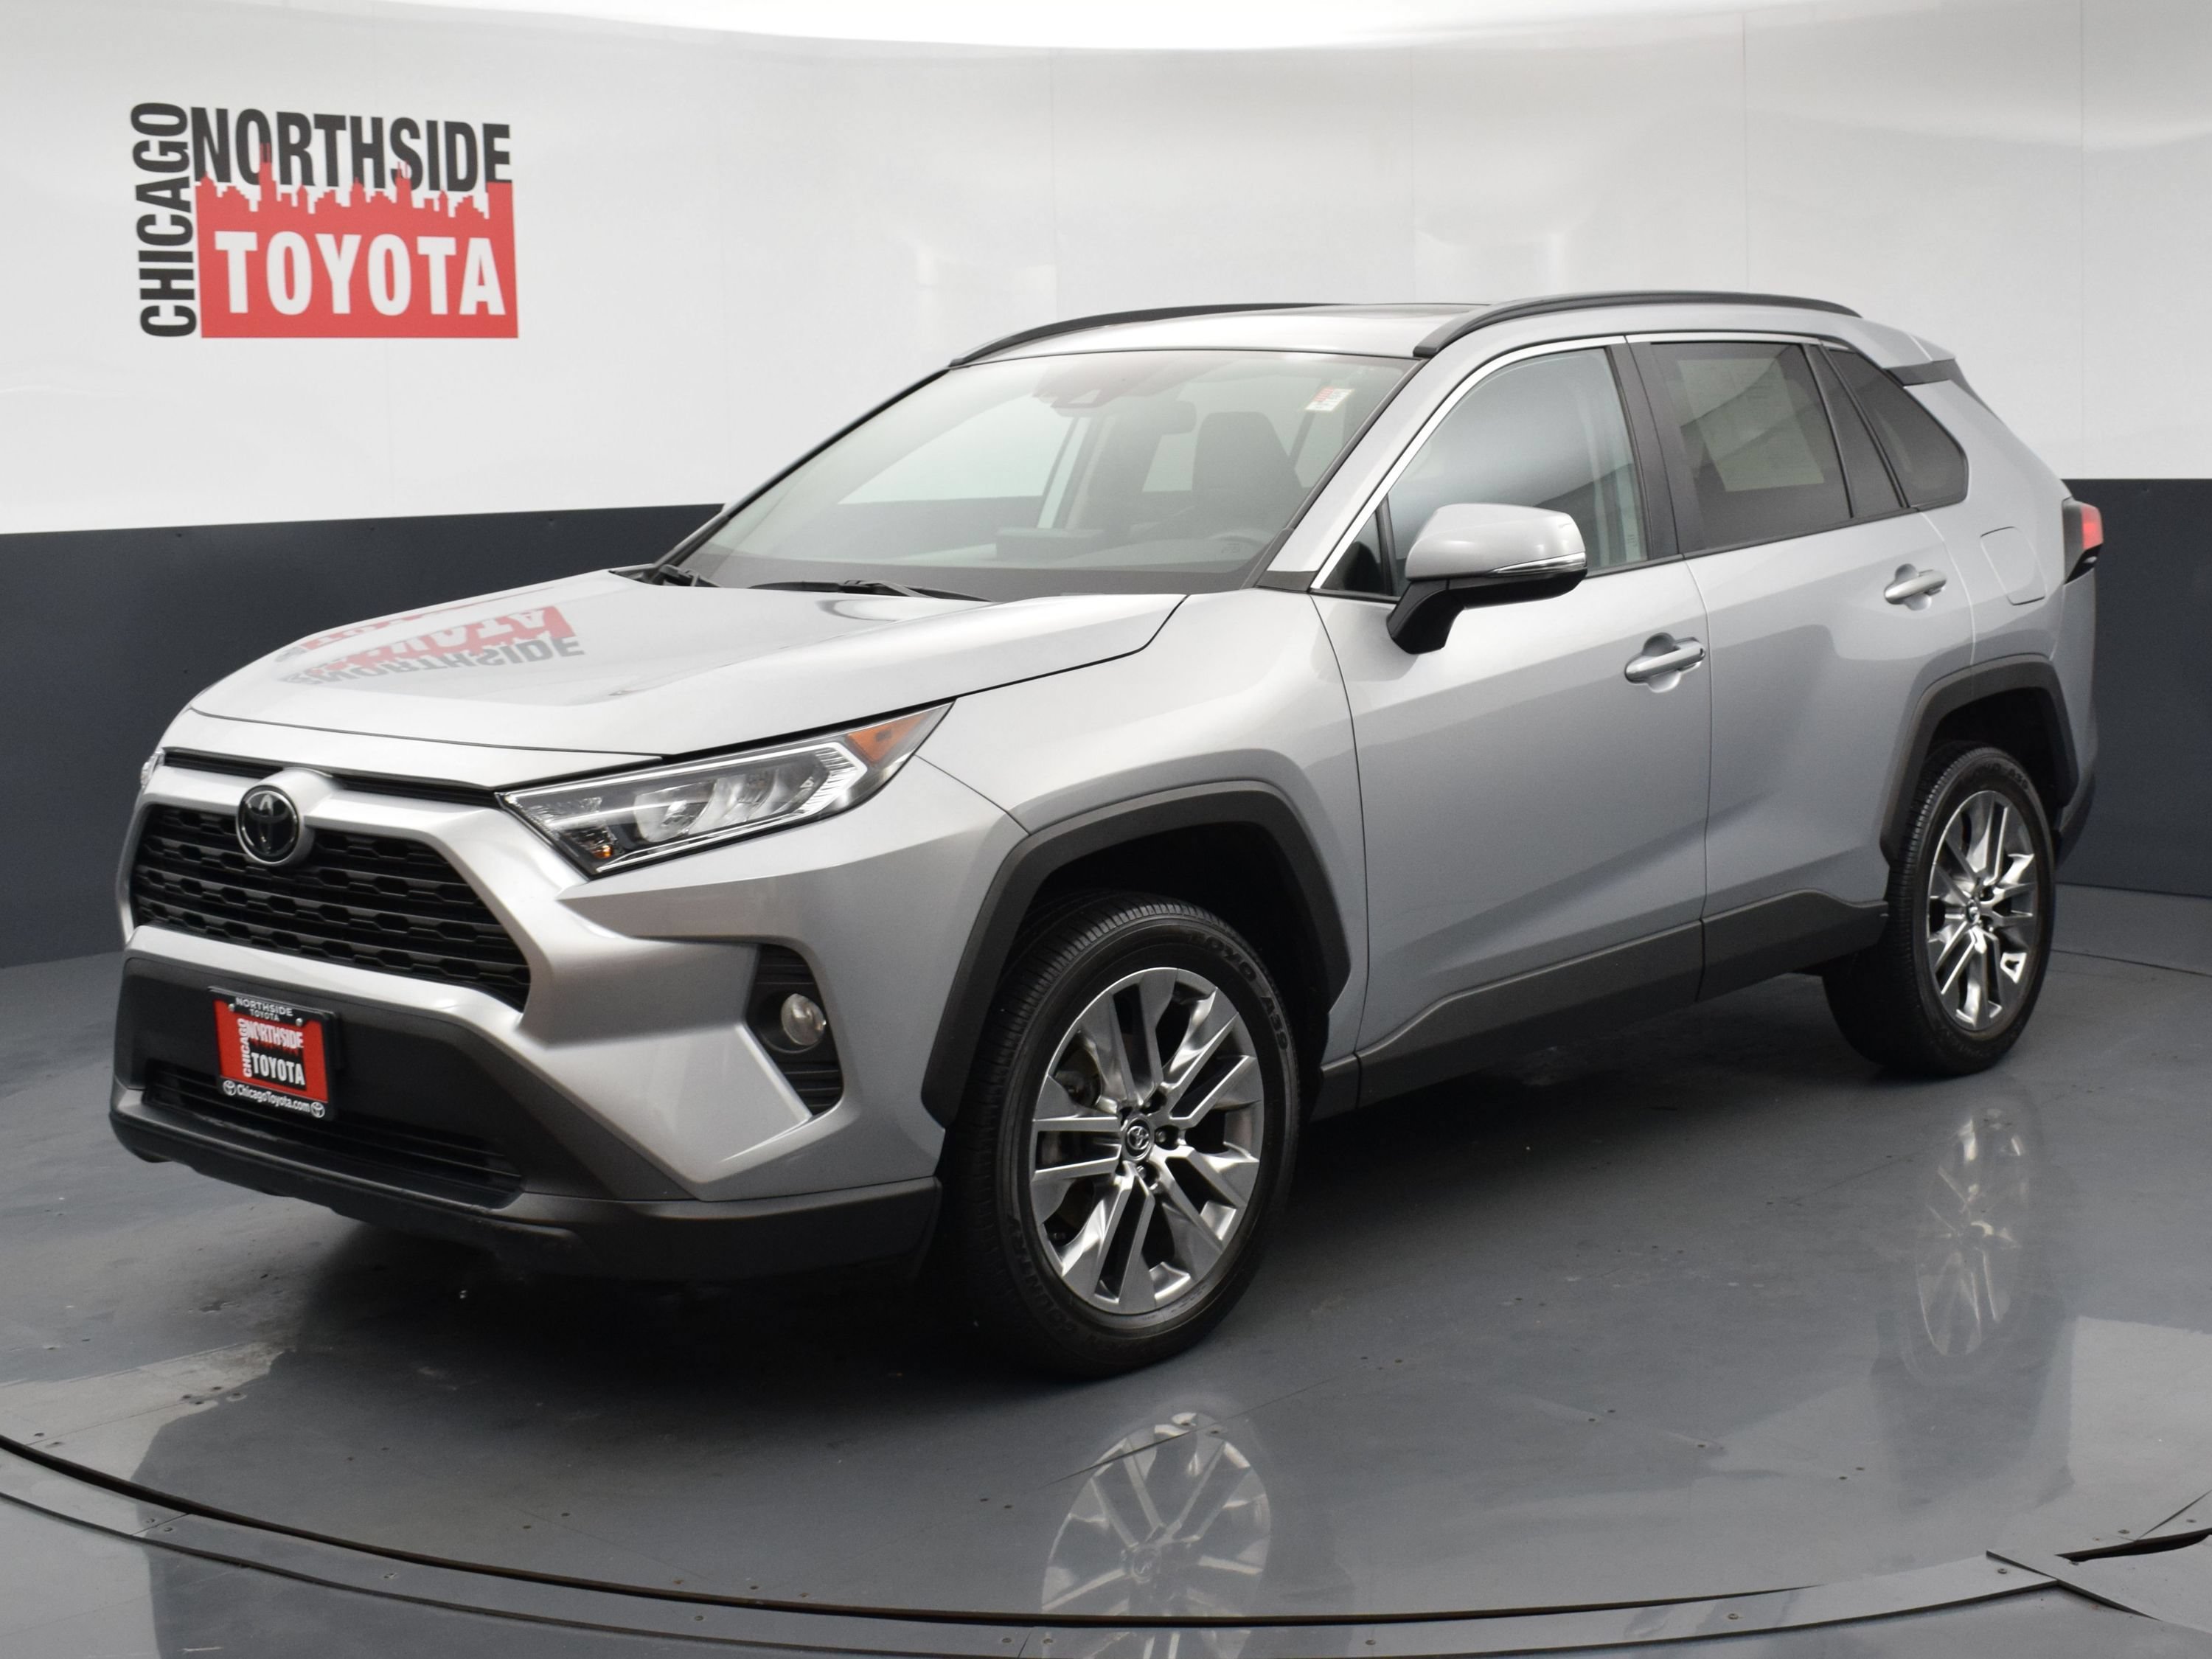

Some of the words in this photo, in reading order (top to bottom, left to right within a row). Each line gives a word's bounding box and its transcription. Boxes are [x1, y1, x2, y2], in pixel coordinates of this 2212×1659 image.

[190, 106, 511, 192] NORTHSIDE
[131, 102, 197, 337] CHICAGO
[214, 230, 507, 316] TOYOTA
[235, 997, 293, 1017] NORTHSIDE
[249, 1009, 280, 1022] TOYOTA
[1260, 997, 1289, 1050] A39
[237, 1018, 253, 1078] CHICAGO
[246, 1020, 305, 1049] NORTHSIDE
[251, 1052, 306, 1086] TOYOTA
[237, 1084, 311, 1113] ChicagoToyota.com
